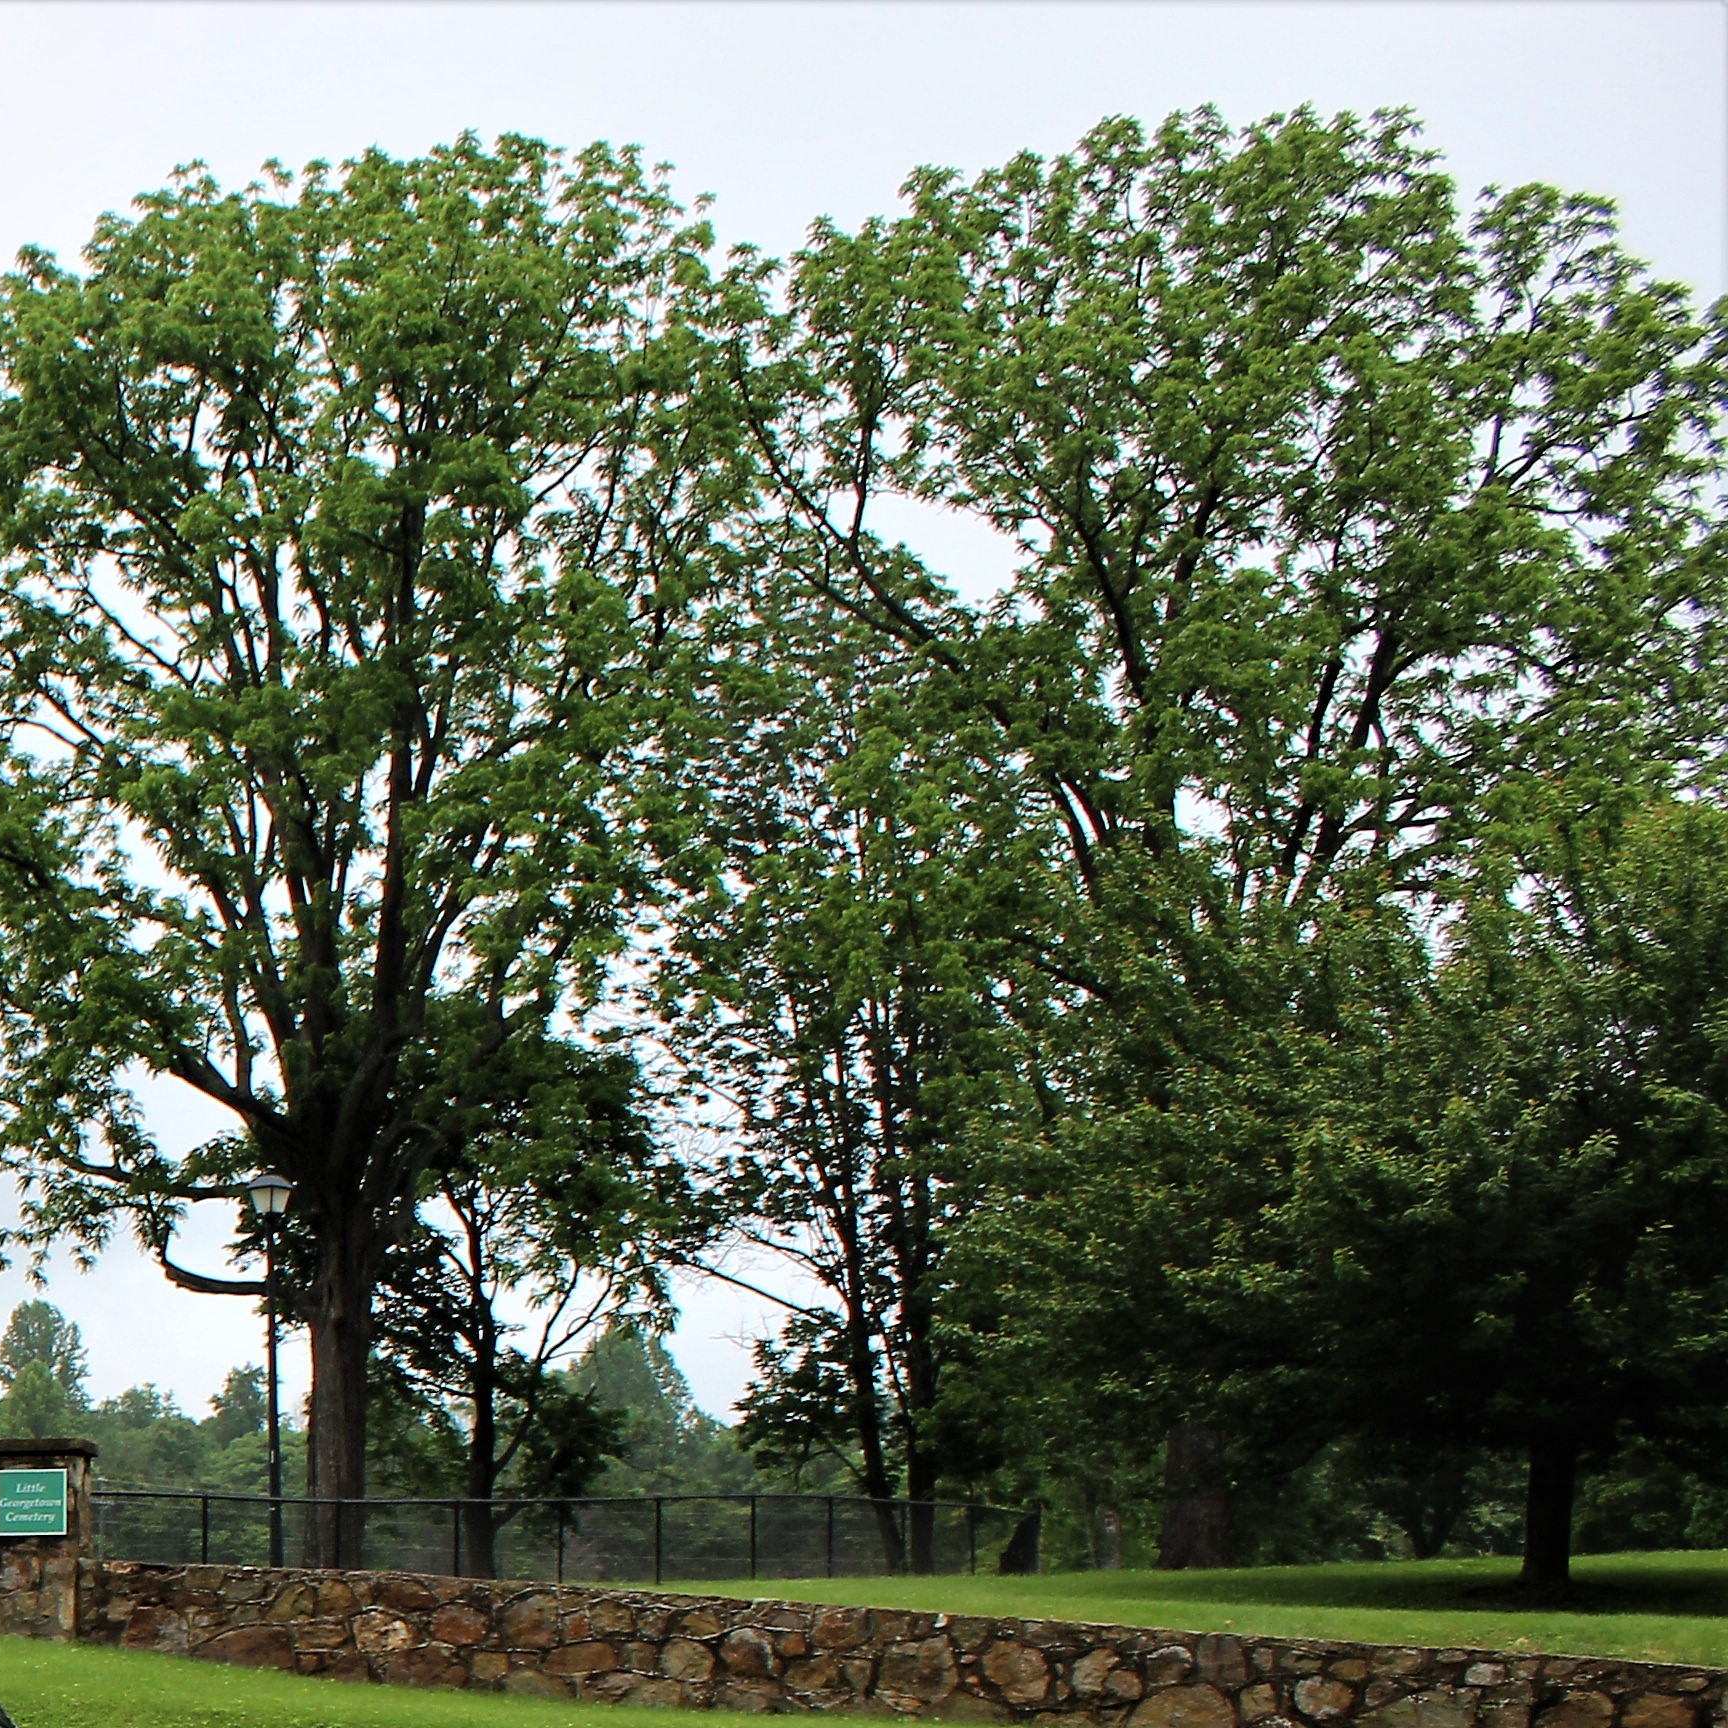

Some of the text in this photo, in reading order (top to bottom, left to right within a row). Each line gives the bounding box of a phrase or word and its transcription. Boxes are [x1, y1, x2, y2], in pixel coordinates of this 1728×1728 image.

[16, 1483, 45, 1493] Little
[0, 1497, 61, 1510] Georgetown
[5, 1512, 56, 1524] Cemetery
